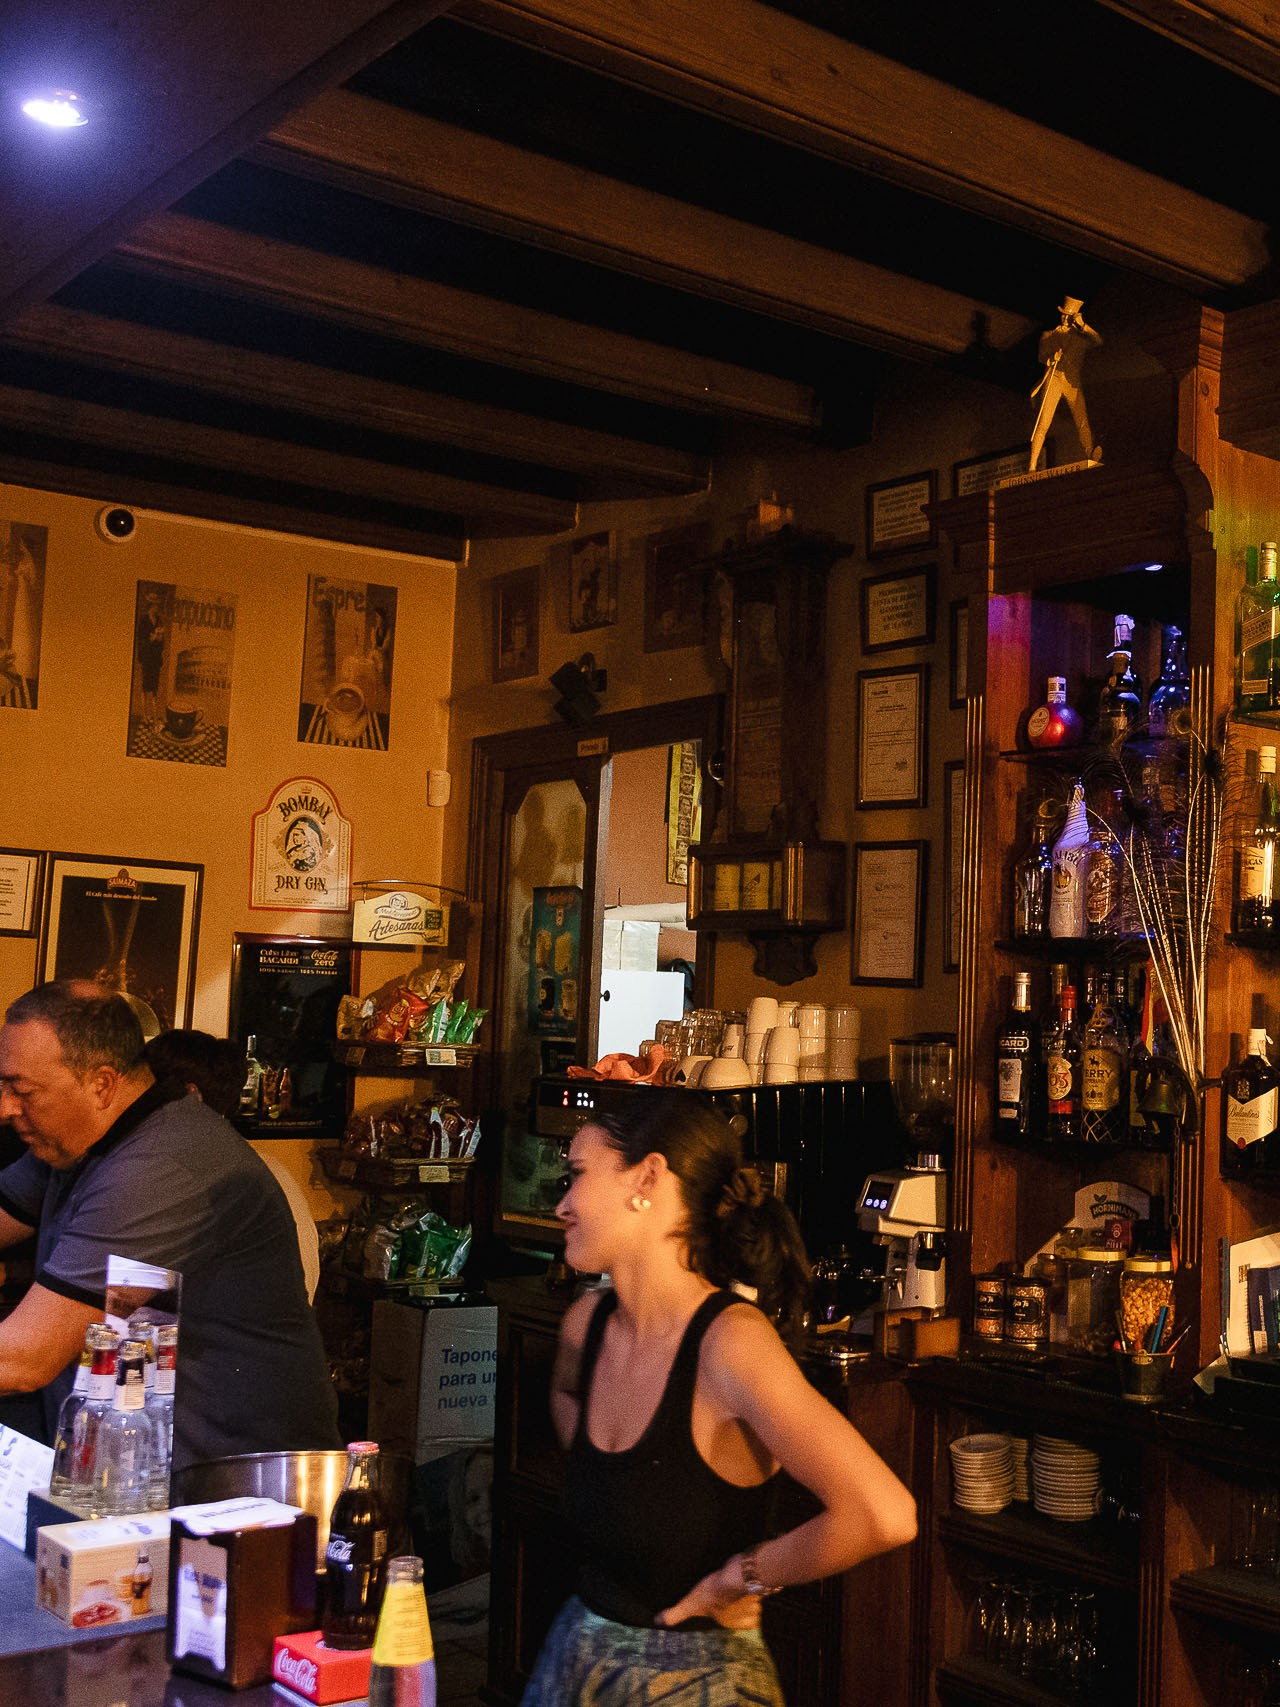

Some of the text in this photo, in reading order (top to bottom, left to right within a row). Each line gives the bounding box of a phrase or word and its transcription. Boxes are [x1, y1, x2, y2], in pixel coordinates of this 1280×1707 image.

[1008, 473, 1043, 488] JOHNNIE
[1046, 464, 1081, 479] WALKER
[276, 794, 333, 824] BOMBAY
[274, 874, 328, 895] DRY GIN
[369, 919, 425, 940] Artesanas
[259, 956, 299, 965] BACARDI
[314, 959, 335, 967] zero
[439, 1373, 477, 1390] para
[437, 1395, 488, 1410] nueva
